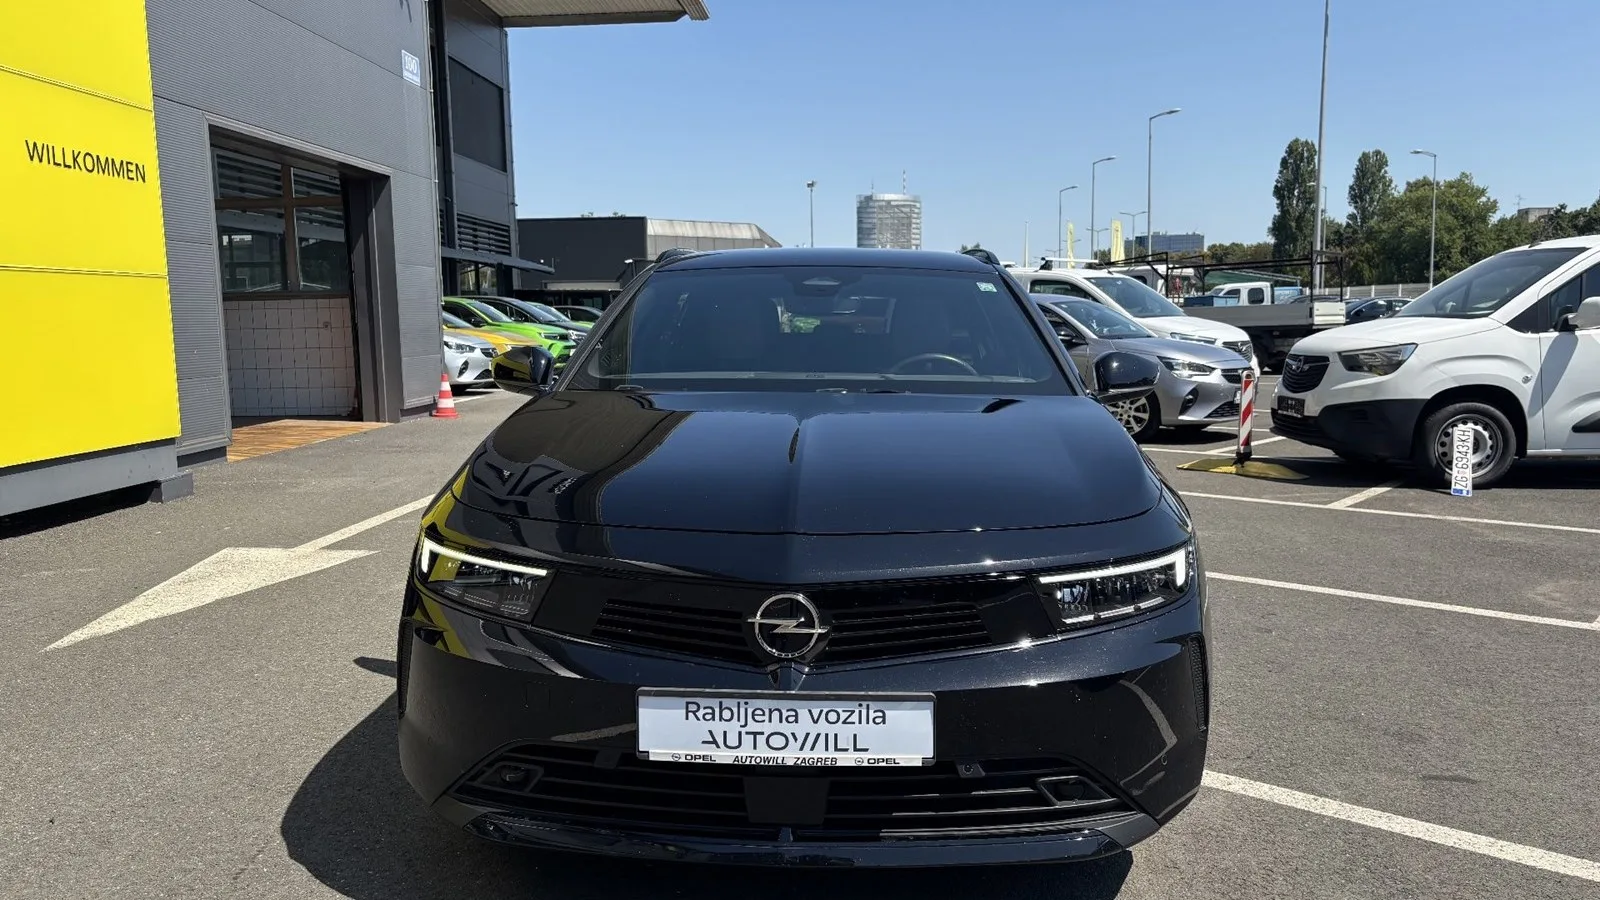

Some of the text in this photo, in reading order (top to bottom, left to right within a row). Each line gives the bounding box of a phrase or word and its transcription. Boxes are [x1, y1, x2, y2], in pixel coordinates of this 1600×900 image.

[25, 139, 146, 183] WILLKOMMEN
[1454, 475, 1468, 489] ZG
[684, 701, 887, 728] Rabljena vozila
[701, 729, 870, 752] AUTOWILL
[684, 753, 901, 766] OPEL AUTOWILL ZAGREB OPEL
